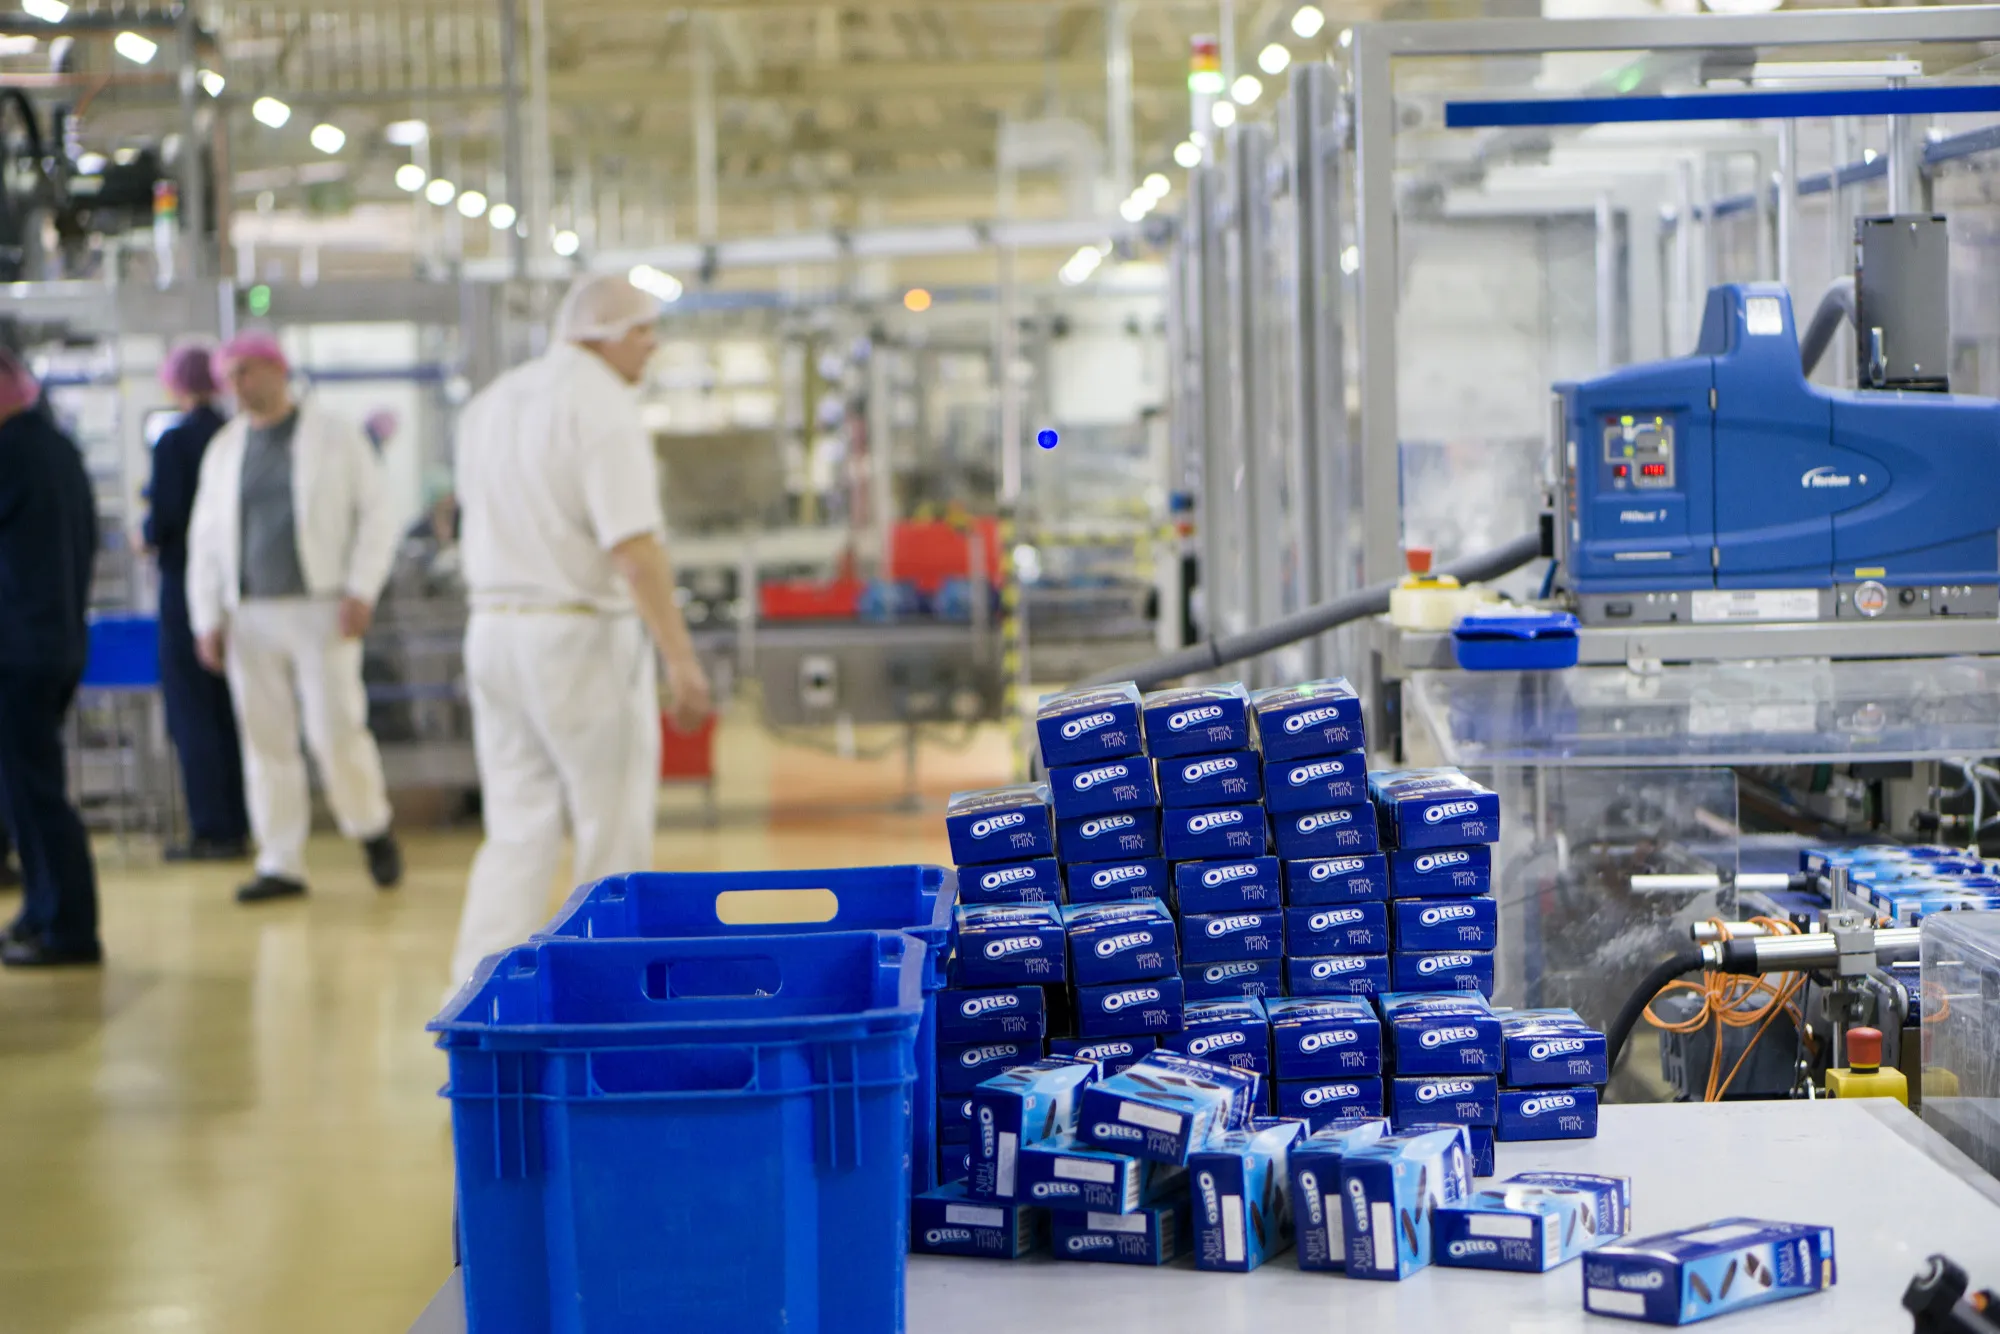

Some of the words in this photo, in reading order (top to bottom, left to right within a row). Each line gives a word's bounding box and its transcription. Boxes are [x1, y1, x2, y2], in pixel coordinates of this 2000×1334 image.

[1061, 713, 1115, 738] OREO
[1169, 706, 1222, 729] OREO
[1286, 708, 1338, 732] OREO
[1103, 737, 1126, 748] THIN
[1209, 731, 1232, 742] THIN
[1326, 732, 1349, 744] THIN
[1076, 766, 1128, 789] OREO
[1184, 758, 1238, 780] OREO
[1291, 762, 1344, 784] OREO
[1114, 791, 1137, 801] THIN
[1224, 784, 1246, 794] THIN
[1330, 787, 1352, 797] THIN
[1190, 811, 1243, 831] OREO
[1298, 811, 1351, 831] OREO
[1425, 802, 1479, 822] OREO
[972, 813, 1026, 836] OREO
[1082, 816, 1134, 836] OREO
[1463, 826, 1485, 837] THIN
[1012, 838, 1035, 849] THIN
[1120, 840, 1143, 850] THIN
[1228, 836, 1250, 846] THIN
[1338, 835, 1360, 845] THIN
[1311, 859, 1363, 880] OREO
[1416, 852, 1470, 871] OREO
[983, 867, 1035, 888] OREO
[1094, 866, 1146, 886] OREO
[1203, 865, 1257, 885] OREO
[1454, 876, 1476, 886] THIN
[1243, 890, 1265, 900] THIN
[1350, 884, 1372, 894] THIN
[1310, 910, 1365, 929] OREO
[1422, 905, 1475, 924] OREO
[1208, 915, 1261, 935] OREO
[1097, 931, 1151, 956] OREO
[1349, 934, 1371, 945] THIN
[1458, 930, 1481, 940] THIN
[987, 937, 1041, 957] OREO
[1246, 940, 1268, 950] THIN
[1026, 963, 1050, 974] THIN
[1138, 958, 1162, 969] THIN
[1205, 963, 1258, 981] OREO
[1313, 958, 1365, 978] OREO
[1418, 955, 1472, 974] OREO
[1351, 983, 1373, 993] THIN
[1456, 978, 1478, 988] THIN
[963, 996, 1016, 1015] OREO
[1104, 989, 1160, 1010] OREO
[1003, 1022, 1026, 1032] THIN
[1145, 1015, 1168, 1026] THIN
[1190, 1032, 1245, 1055] OREO
[1302, 1030, 1357, 1051] OREO
[1421, 1027, 1478, 1046] OREO
[962, 1045, 1016, 1065] OREO
[1078, 1043, 1132, 1060] OREO
[1462, 1054, 1485, 1064] THIN
[1531, 1040, 1585, 1059] OREO
[1342, 1056, 1365, 1067] THIN
[1569, 1065, 1591, 1075] THIN
[1304, 1085, 1359, 1105] OREO
[1418, 1081, 1473, 1102] OREO
[1458, 1107, 1481, 1118] THIN
[1522, 1096, 1575, 1115] OREO
[981, 1107, 993, 1156] OREO
[1094, 1124, 1143, 1139] OREO
[1560, 1120, 1582, 1130] THIN
[1033, 1183, 1079, 1197] OREO
[1200, 1172, 1218, 1224] OREO
[1302, 1172, 1321, 1223] OREO
[1349, 1179, 1368, 1231] OREO
[926, 1230, 970, 1243] OREO
[1068, 1236, 1113, 1250] OREO
[1449, 1241, 1497, 1256] OREO
